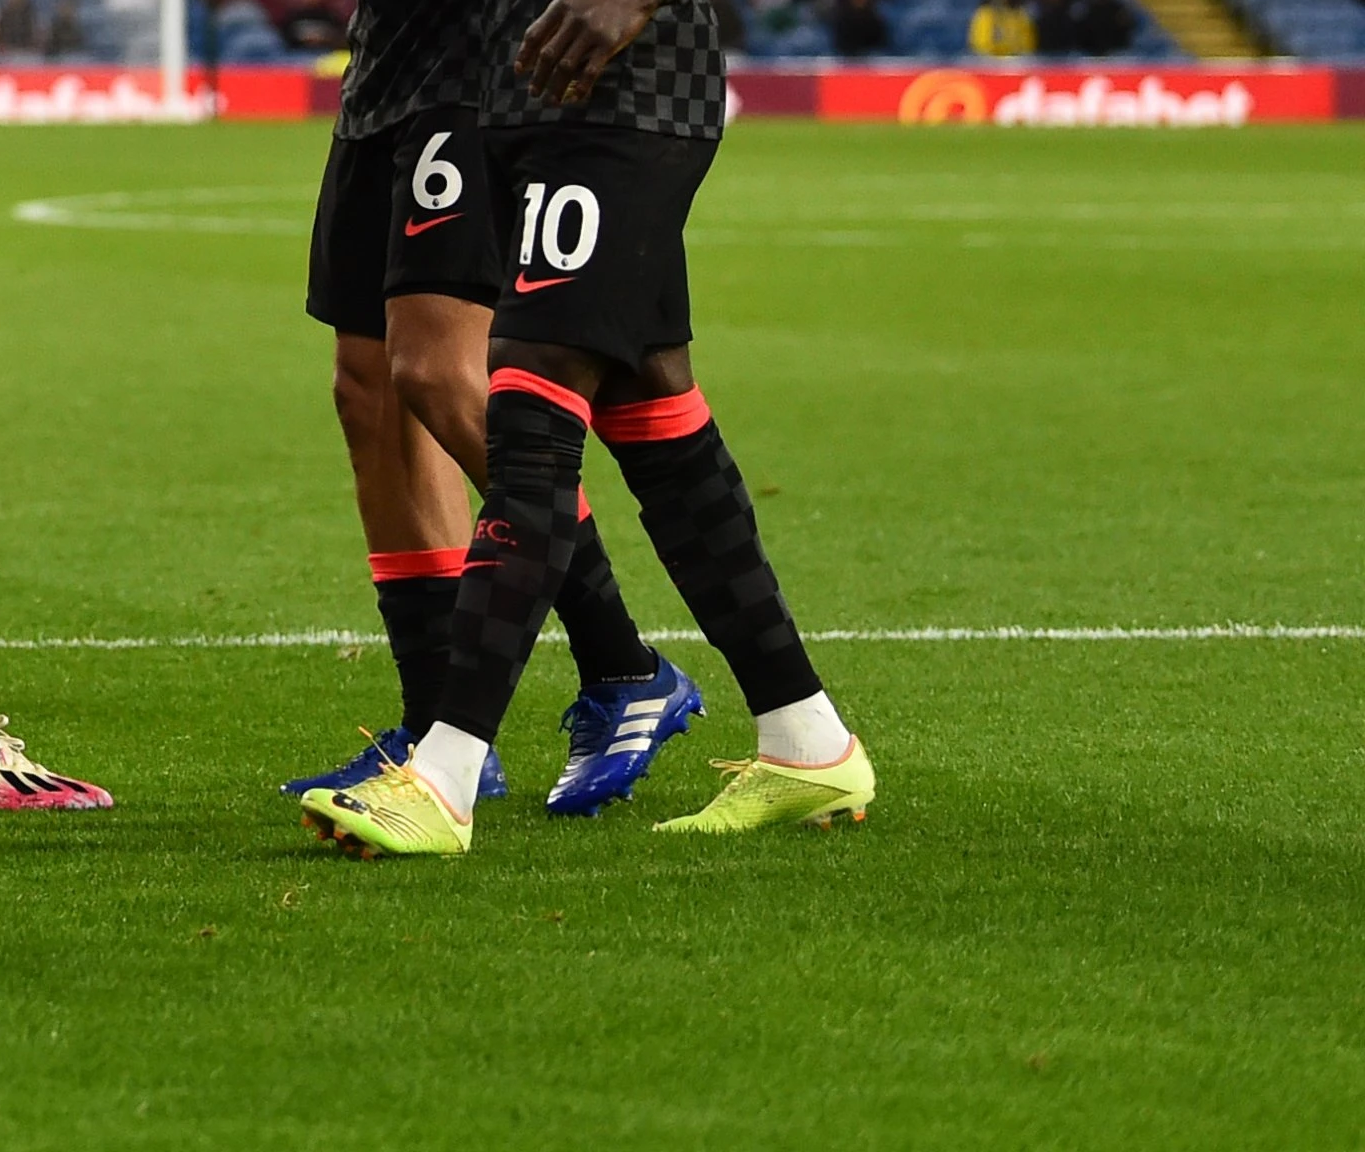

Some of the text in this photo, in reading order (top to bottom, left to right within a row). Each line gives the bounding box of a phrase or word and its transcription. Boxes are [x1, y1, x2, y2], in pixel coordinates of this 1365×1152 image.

[993, 74, 1253, 127] dafabet
[412, 131, 464, 210] 6
[519, 182, 601, 271] 10
